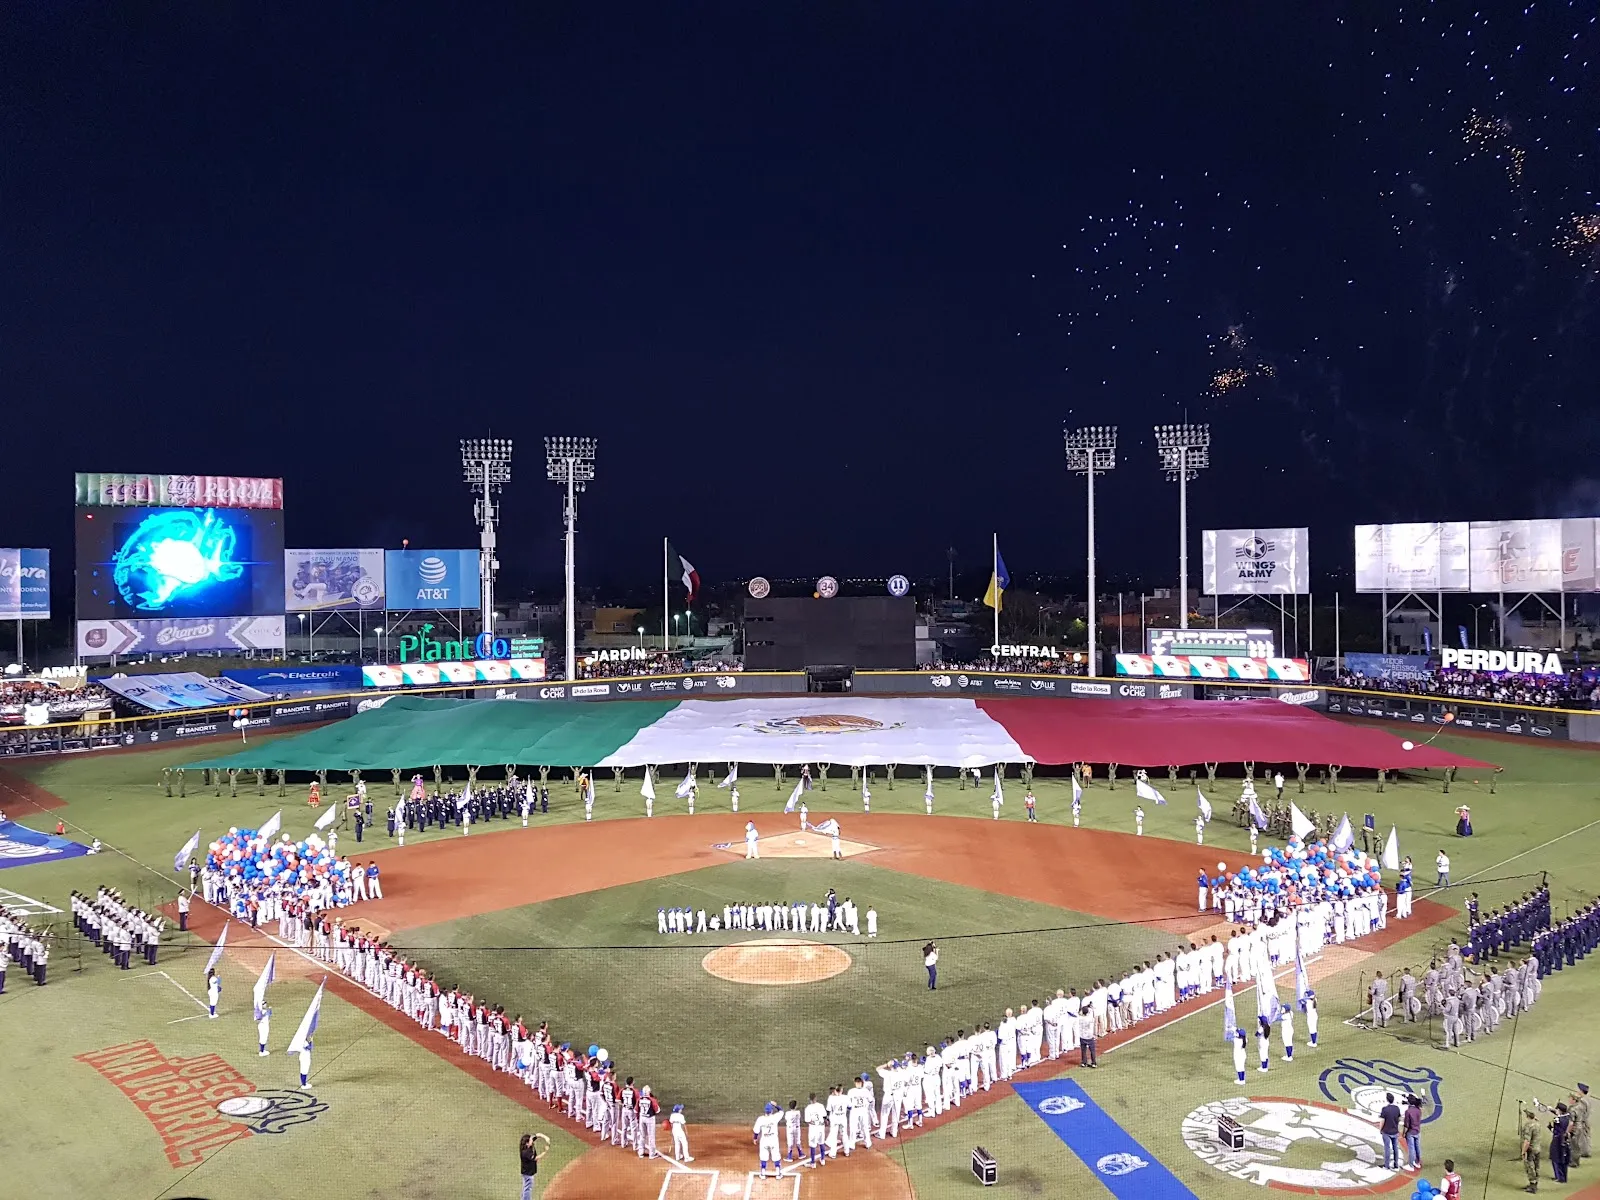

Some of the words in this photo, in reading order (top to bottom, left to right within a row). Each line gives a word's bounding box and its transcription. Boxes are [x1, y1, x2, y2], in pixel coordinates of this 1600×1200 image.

[1238, 570, 1274, 578] ARMY
[821, 582, 834, 592] 34
[893, 580, 904, 590] 11
[416, 588, 450, 600] AT&T
[156, 623, 215, 646] Charros
[590, 645, 647, 662] JARDÍN
[990, 644, 1060, 658] CENTRAL
[1442, 648, 1564, 675] PERDURA
[41, 665, 88, 679] ARMY
[288, 670, 341, 680] Electrolit
[1278, 690, 1319, 705] Charros
[282, 705, 311, 714] BANORTE
[322, 701, 349, 710] BANORTE
[184, 724, 217, 734] BANORTE
[78, 1040, 250, 1165] INAUGURAL
